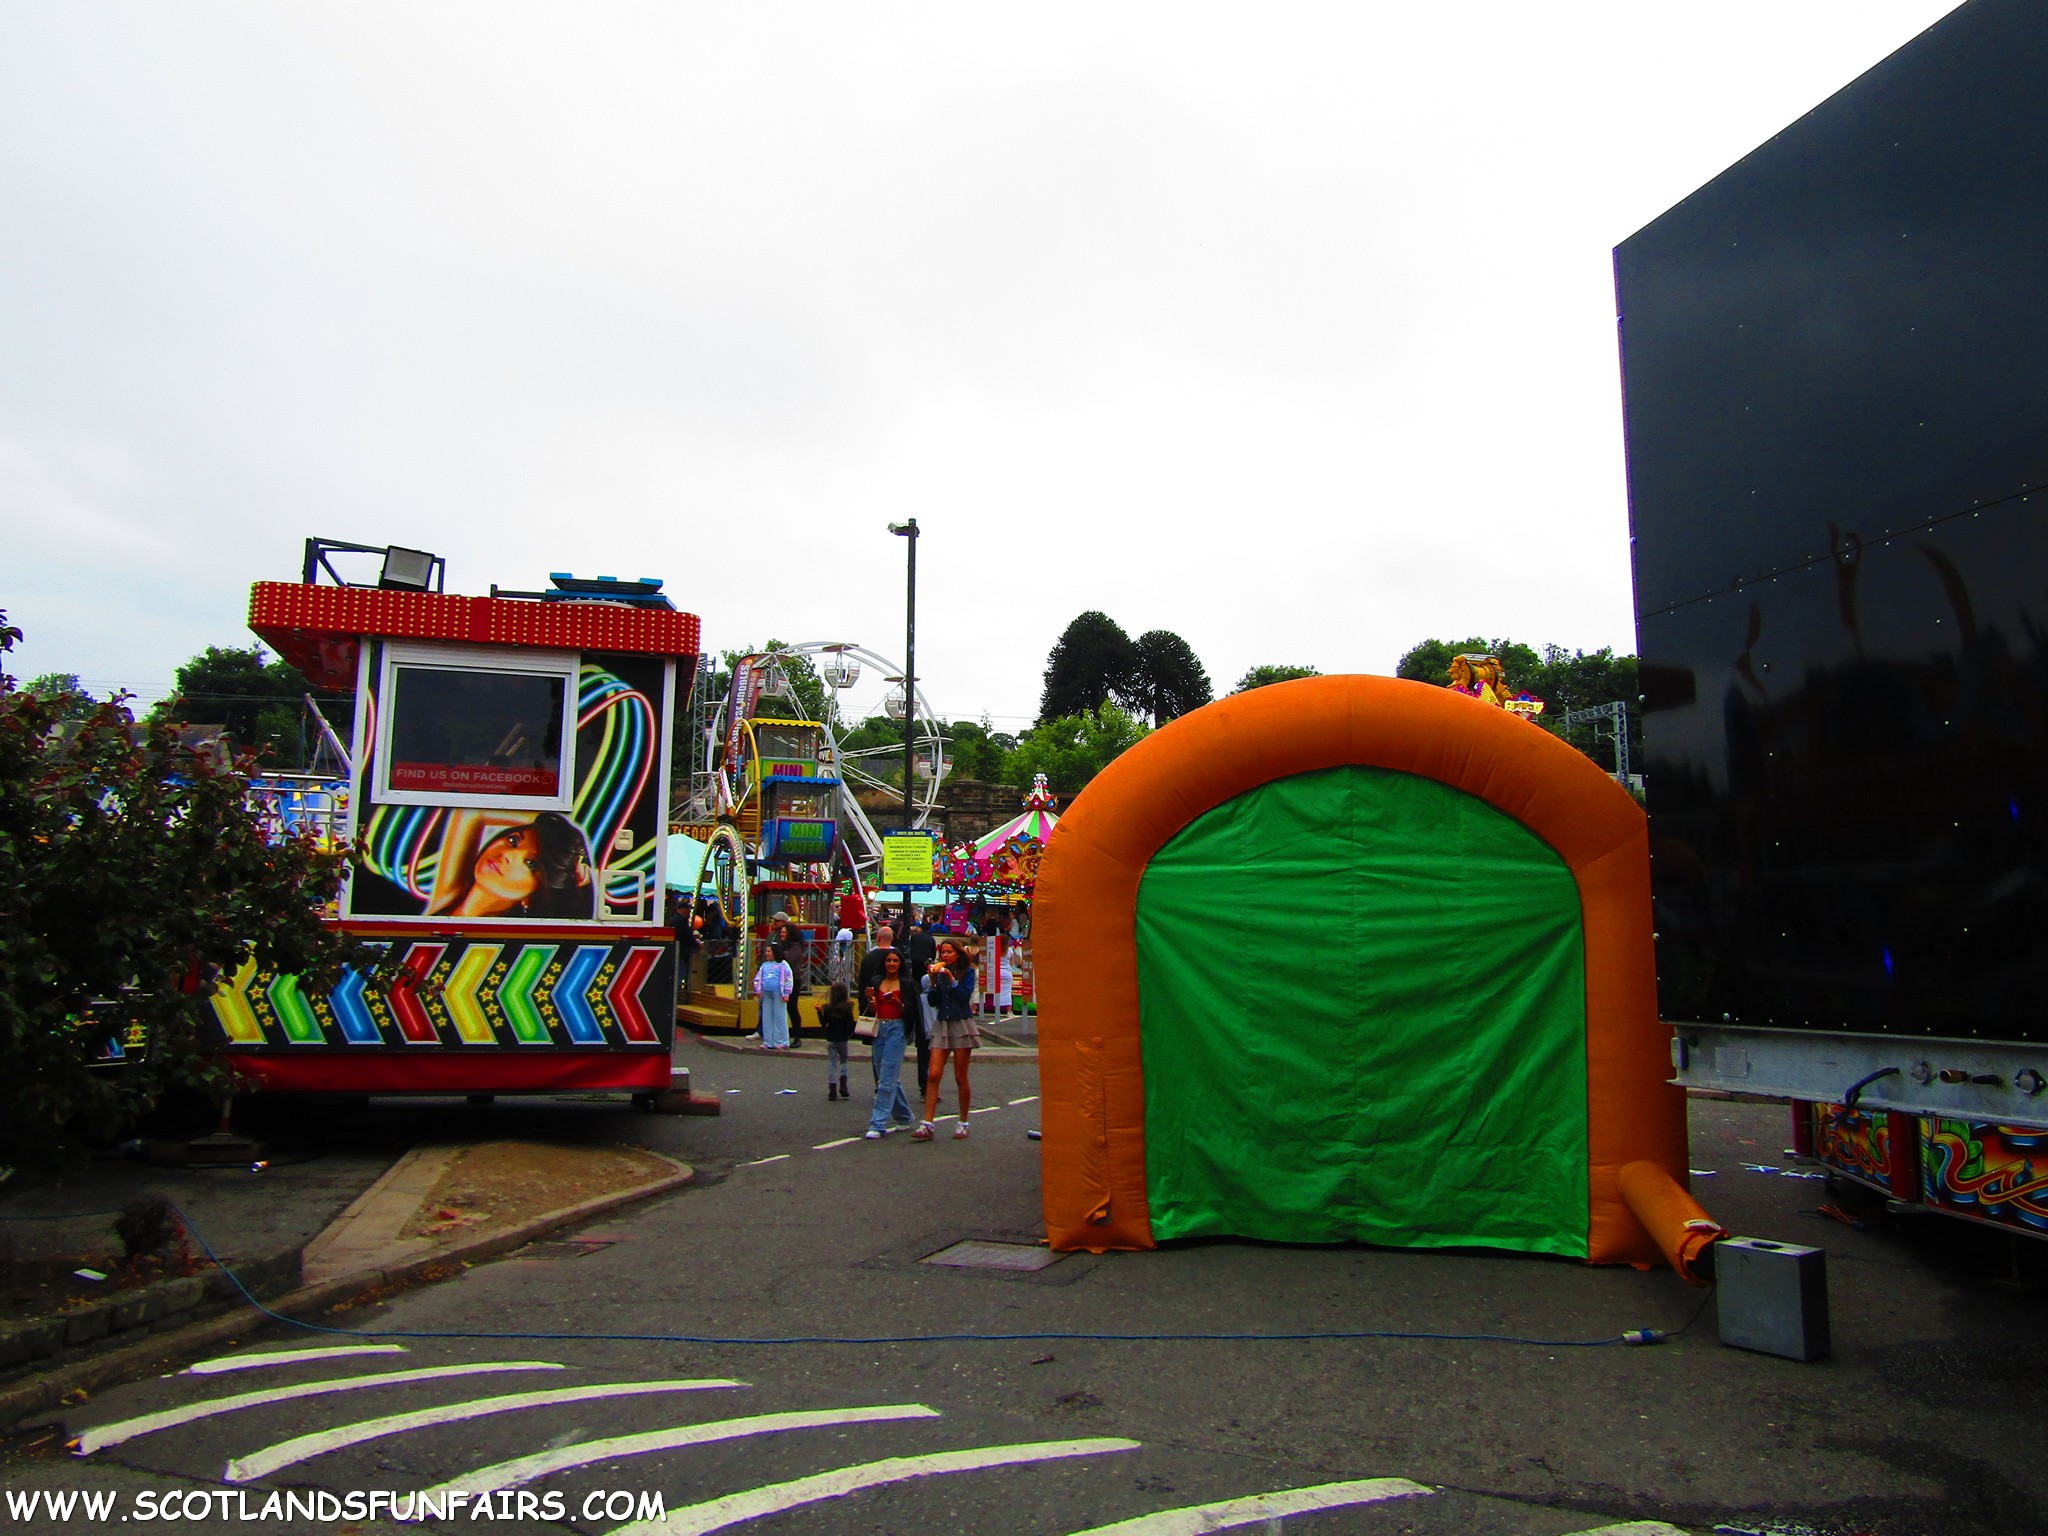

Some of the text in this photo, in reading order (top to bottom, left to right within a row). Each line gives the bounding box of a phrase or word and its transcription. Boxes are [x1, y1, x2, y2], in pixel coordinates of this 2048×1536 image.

[396, 768, 541, 784] FIND US ON FACEBOOK
[773, 763, 803, 776] MINI
[789, 823, 823, 839] MINI
